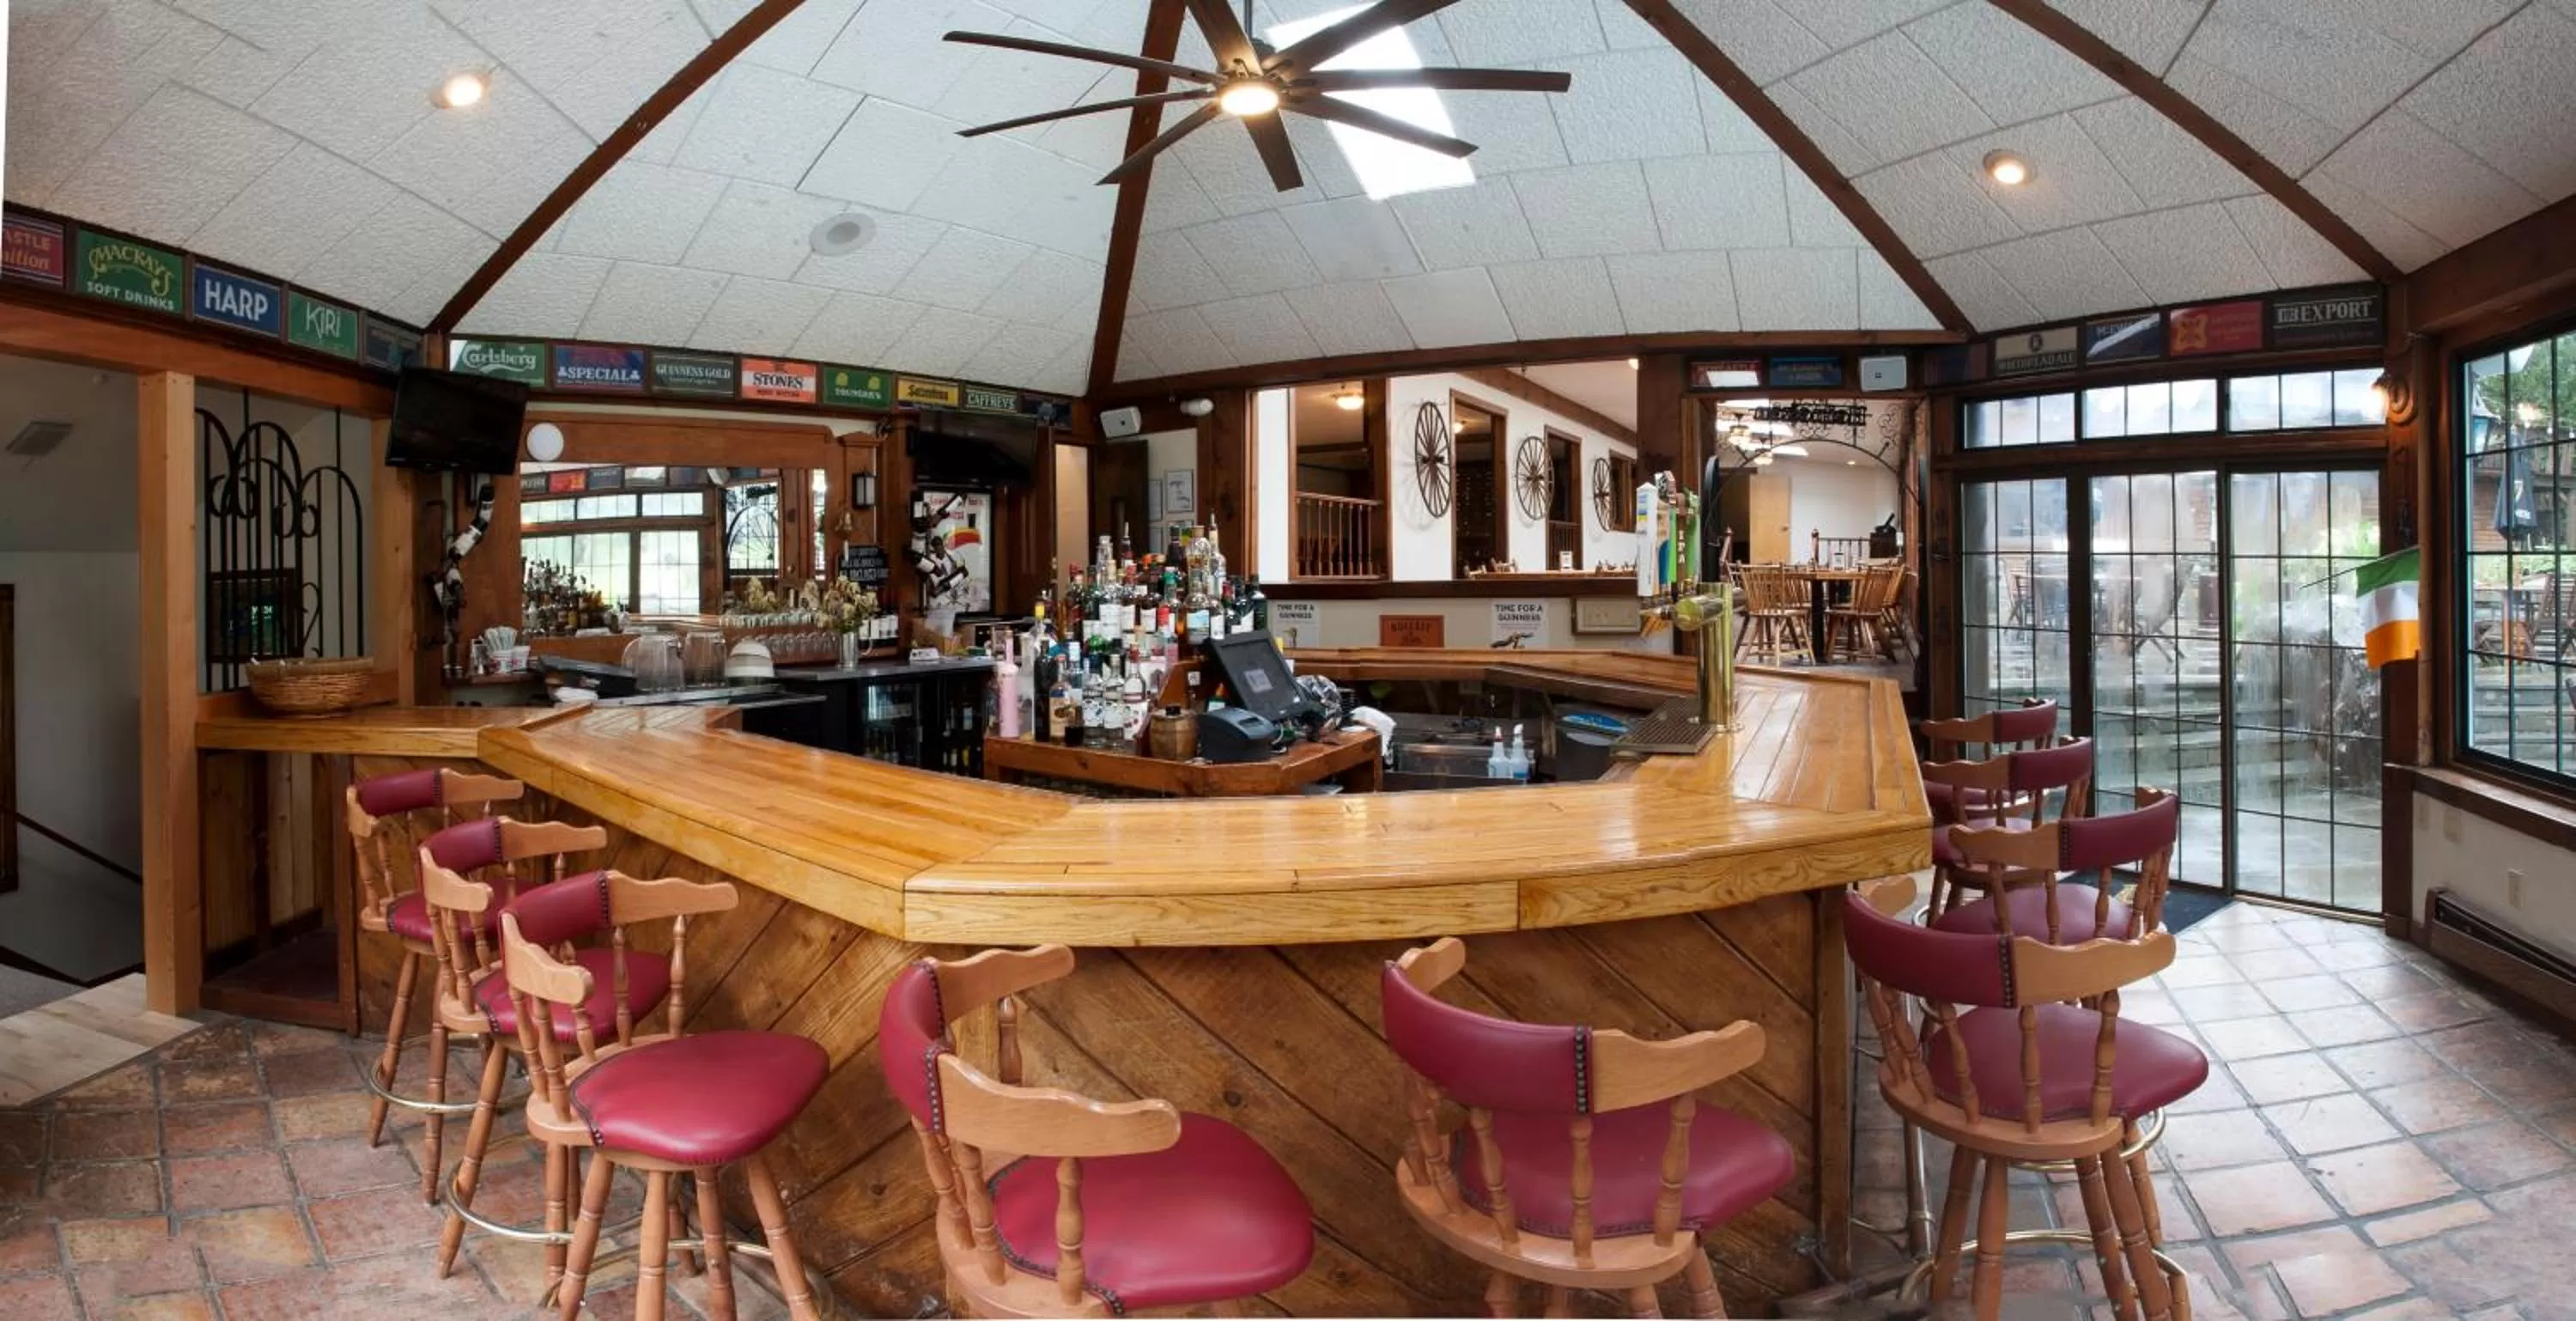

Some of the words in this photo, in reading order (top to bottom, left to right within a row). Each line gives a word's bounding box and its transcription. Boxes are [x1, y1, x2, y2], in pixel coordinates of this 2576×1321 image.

[87, 281, 120, 299] SOFT
[125, 289, 175, 310] DRINKS
[204, 277, 268, 322] HARP
[2301, 301, 2373, 323] EXPORT
[463, 344, 537, 371] Carlsberg
[567, 367, 629, 381] SPECIAL
[753, 372, 805, 389] STONES
[1495, 604, 1516, 612] TIME
[1517, 604, 1534, 612] FOR
